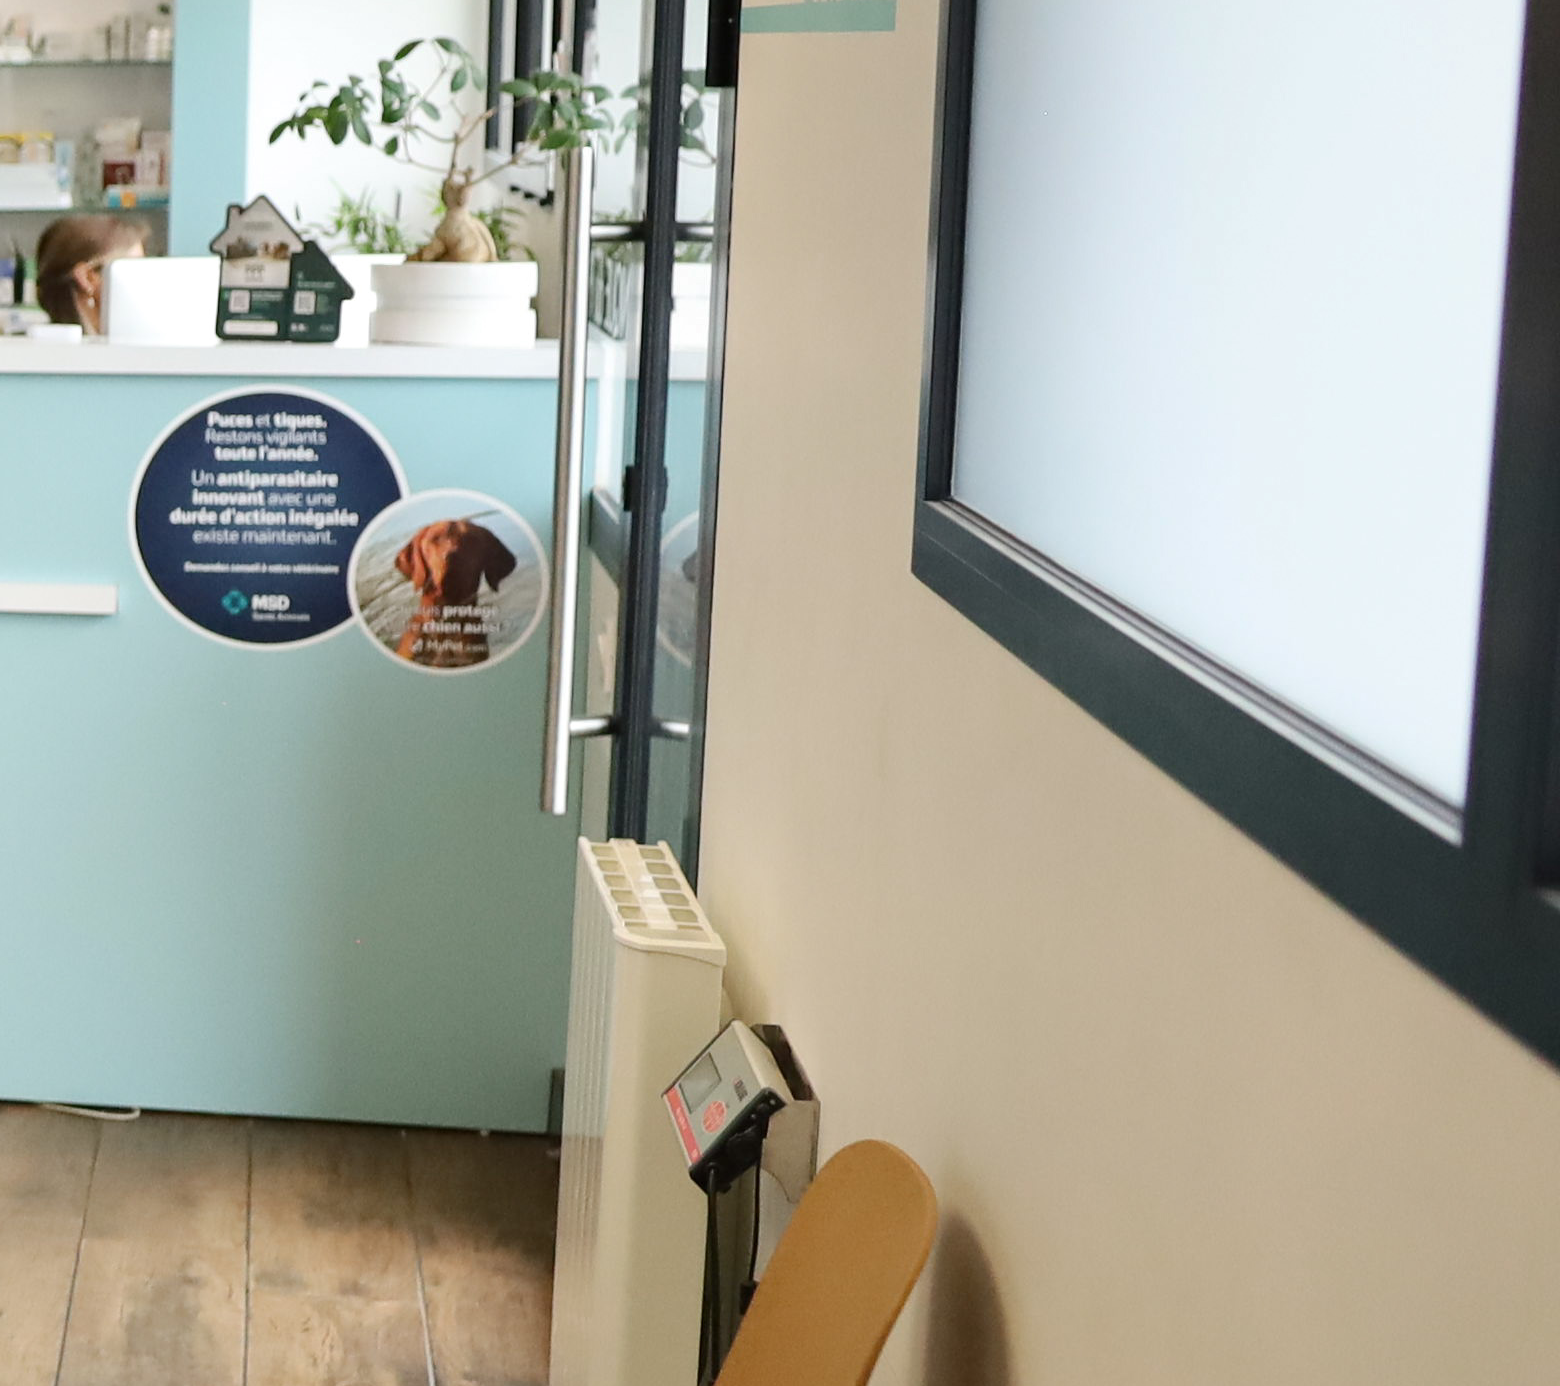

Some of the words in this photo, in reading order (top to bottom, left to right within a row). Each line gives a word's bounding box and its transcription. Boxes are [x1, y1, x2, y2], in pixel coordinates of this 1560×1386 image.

[207, 410, 254, 429] Puces
[255, 412, 270, 428] et
[273, 411, 328, 433] tiques.
[205, 427, 264, 445] Restons
[266, 428, 327, 447] vigilants
[214, 445, 257, 461] toute
[258, 445, 319, 461] l'année.
[191, 469, 215, 487] Un
[216, 469, 339, 489] antiparasitaire
[266, 492, 303, 507] avec
[305, 493, 337, 507] une
[169, 507, 218, 525] durée
[219, 507, 287, 525] d'action
[288, 508, 360, 529] inégalée
[192, 528, 240, 544] existe
[241, 528, 338, 545] maintenant.
[251, 594, 291, 612] MSD
[422, 619, 462, 633] chien
